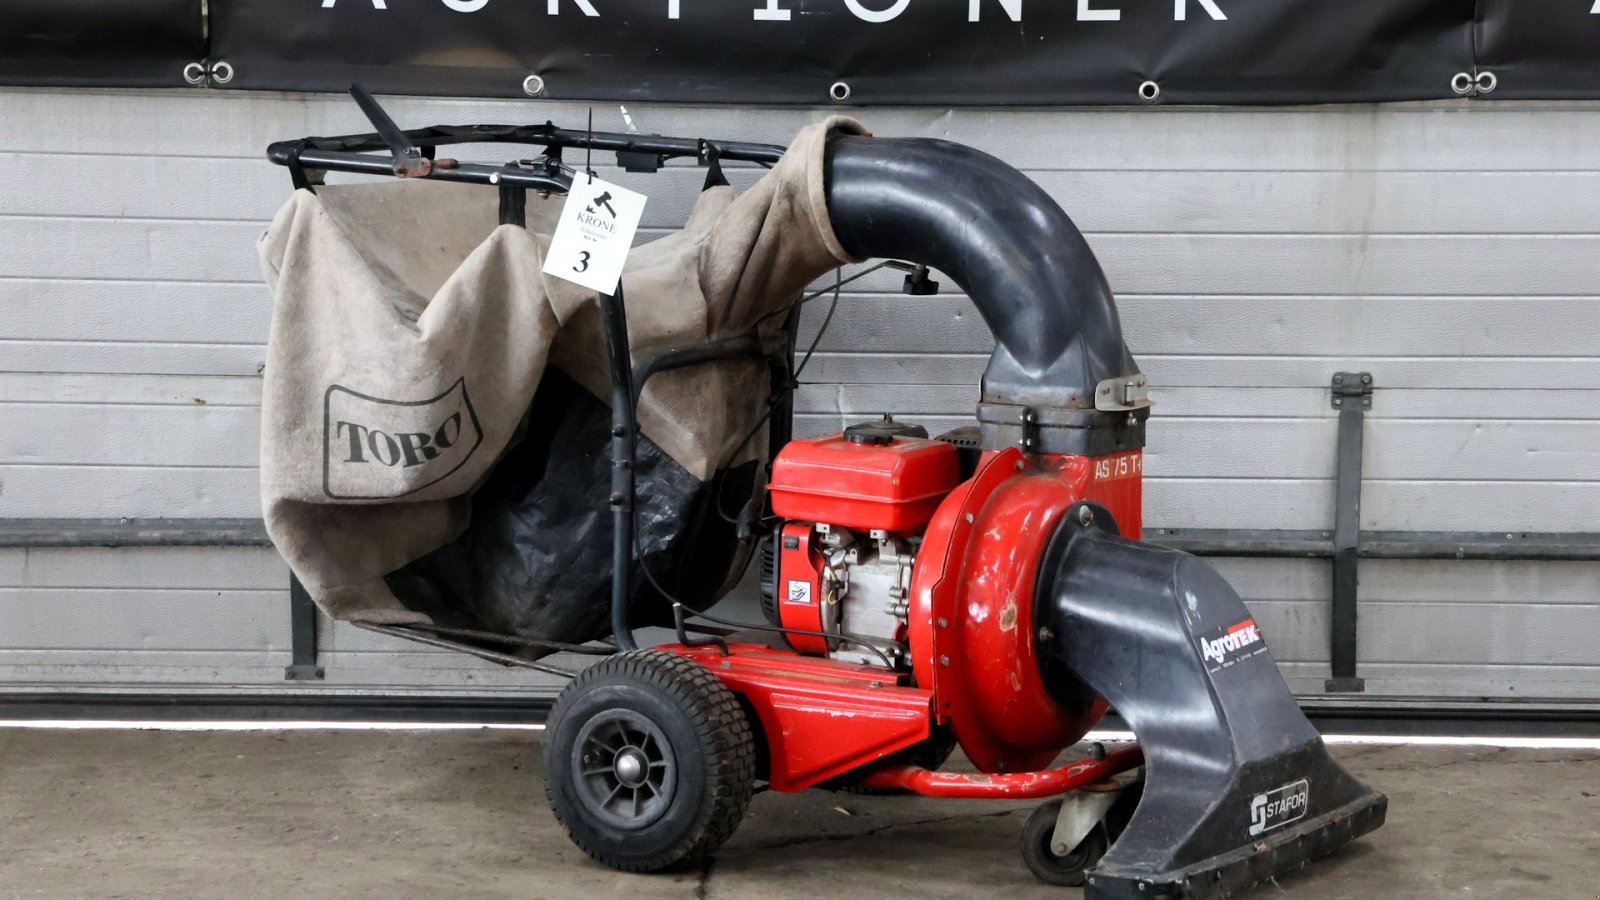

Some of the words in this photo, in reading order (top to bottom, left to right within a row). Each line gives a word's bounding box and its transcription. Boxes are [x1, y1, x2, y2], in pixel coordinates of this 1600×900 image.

[577, 212, 616, 234] KRONE
[572, 250, 591, 273] 3
[337, 411, 462, 468] TORO
[1094, 459, 1110, 480] AS
[1114, 456, 1128, 477] 75
[1200, 624, 1260, 664] AgroTEK
[1267, 792, 1306, 818] STAFOR
